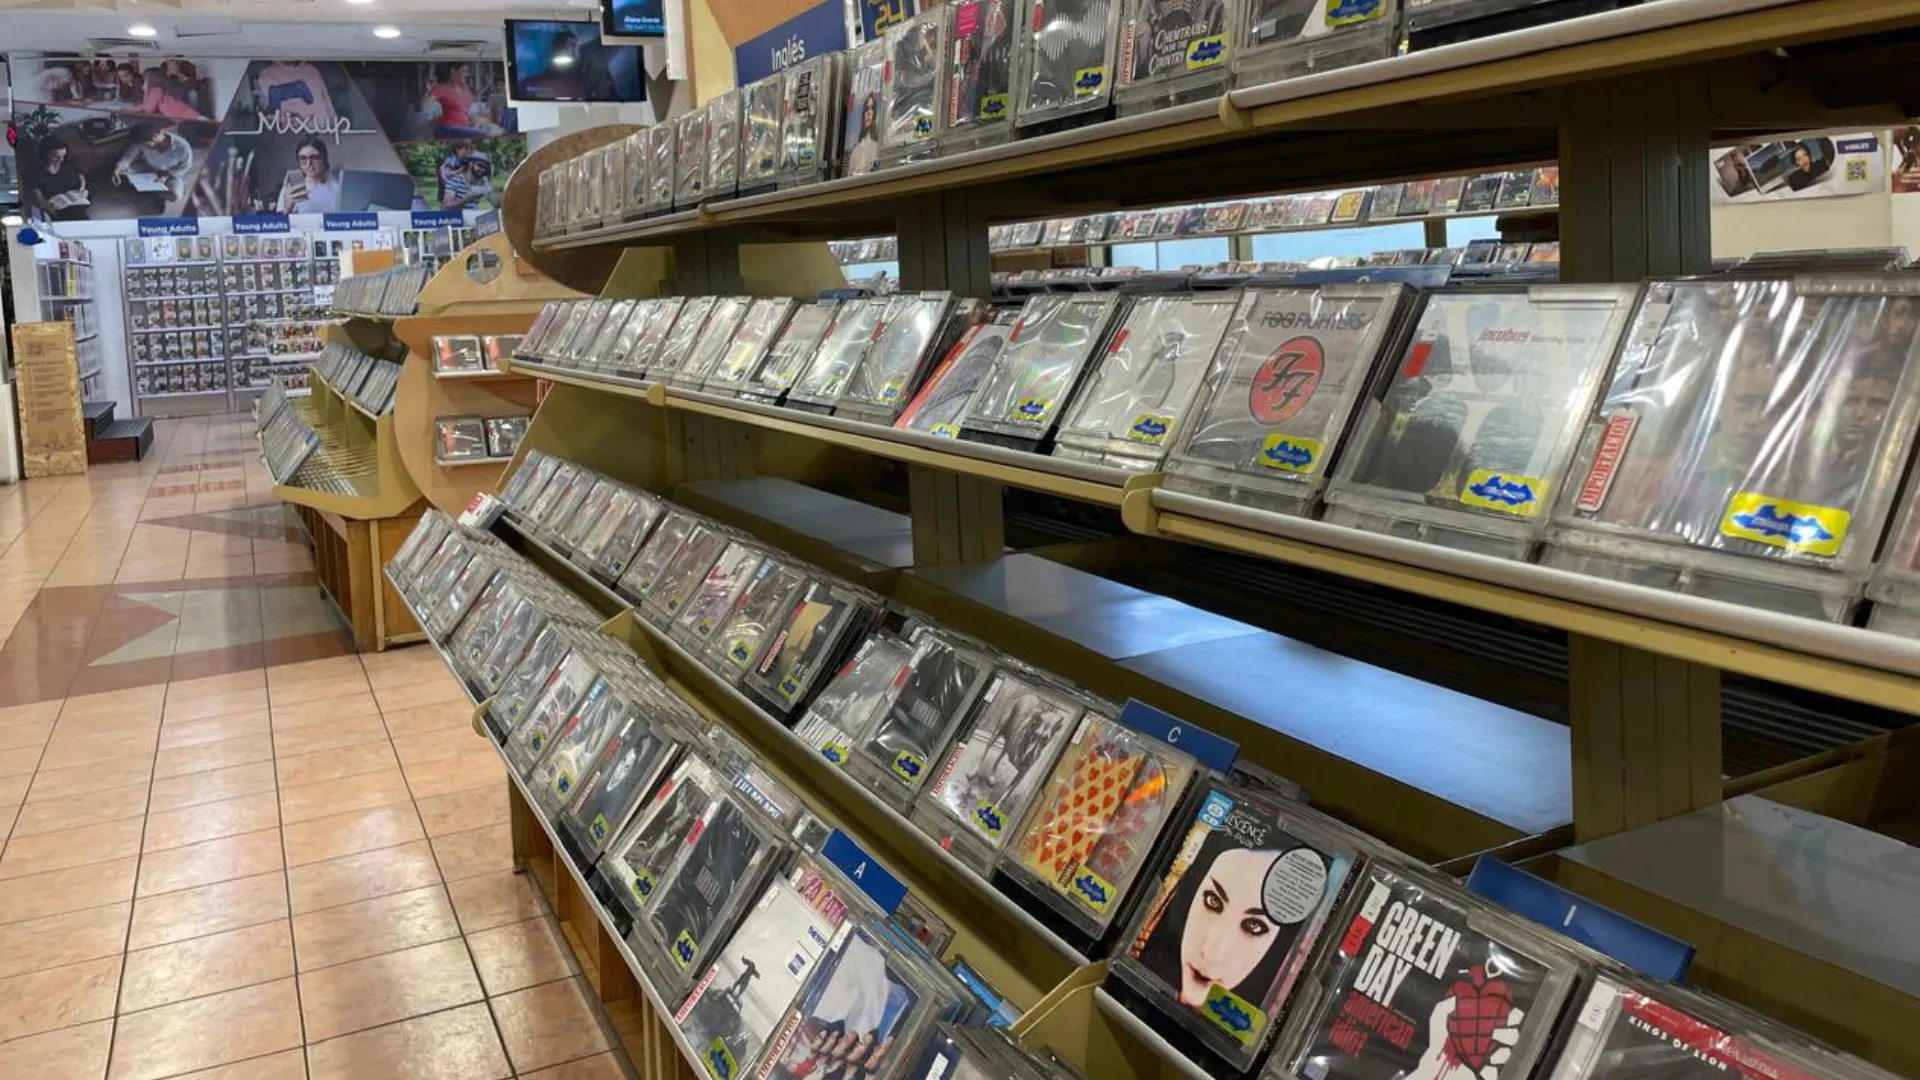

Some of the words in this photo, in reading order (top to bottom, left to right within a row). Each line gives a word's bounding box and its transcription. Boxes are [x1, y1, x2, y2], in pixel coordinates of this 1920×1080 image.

[771, 34, 806, 71] Inglés
[240, 110, 366, 146] Mixup
[326, 219, 351, 229] Young
[352, 219, 377, 228] Adults
[1260, 310, 1296, 329] FOO
[1579, 415, 1634, 508] IMPORTACION
[1167, 726, 1182, 743] C
[853, 861, 867, 879] A
[1376, 901, 1462, 980] GREEN
[1353, 942, 1413, 1008] DAY
[1628, 1015, 1667, 1042] KINGS
[1672, 1038, 1689, 1053] OF
[1692, 1049, 1728, 1073] LEON
